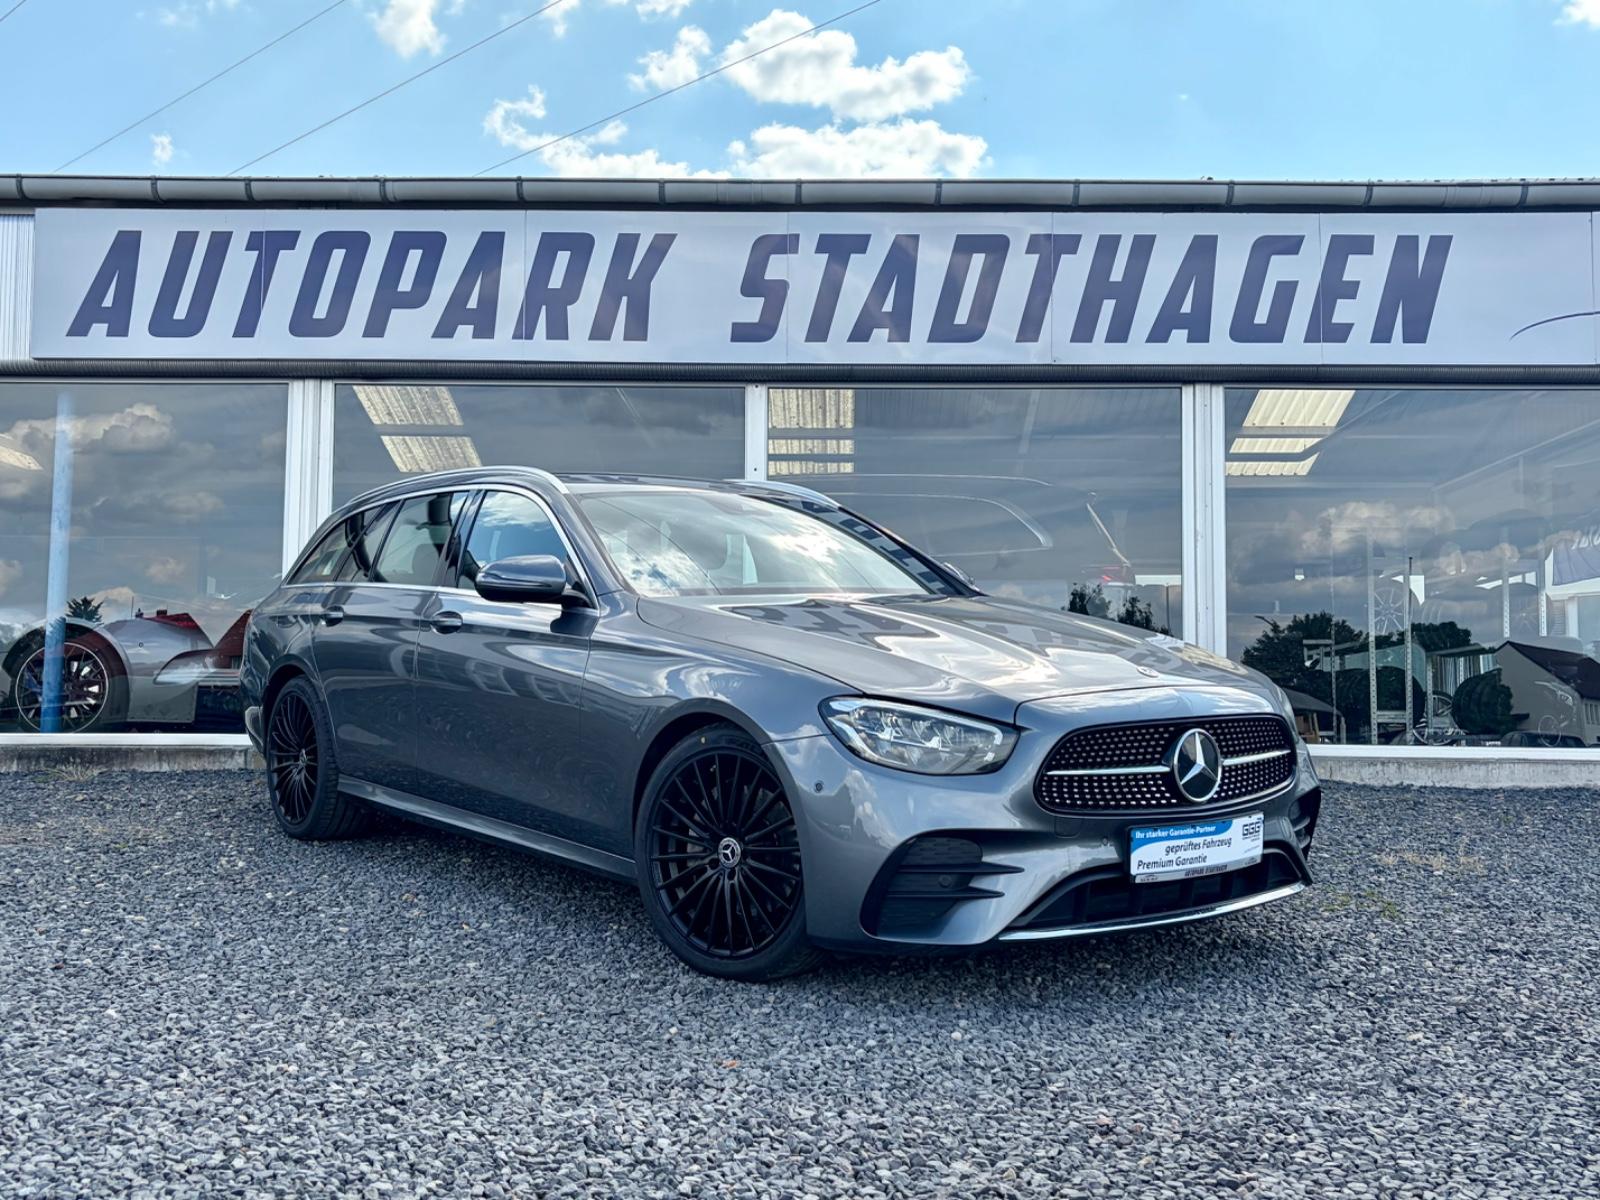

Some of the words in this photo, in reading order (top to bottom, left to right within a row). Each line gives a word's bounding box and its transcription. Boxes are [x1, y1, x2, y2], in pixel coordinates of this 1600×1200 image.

[66, 230, 678, 341] AUTOPARK
[730, 233, 1453, 344] STADTHAGEN
[1135, 830, 1145, 839] Ihr
[1146, 829, 1169, 839] starker
[1170, 825, 1216, 837] Garantie-Partner
[1242, 821, 1261, 836] GGG
[1165, 840, 1201, 856] geprüftes
[1202, 837, 1232, 850] Fahrzeug
[1137, 856, 1174, 870] Premium
[1175, 854, 1208, 866] Garantie
